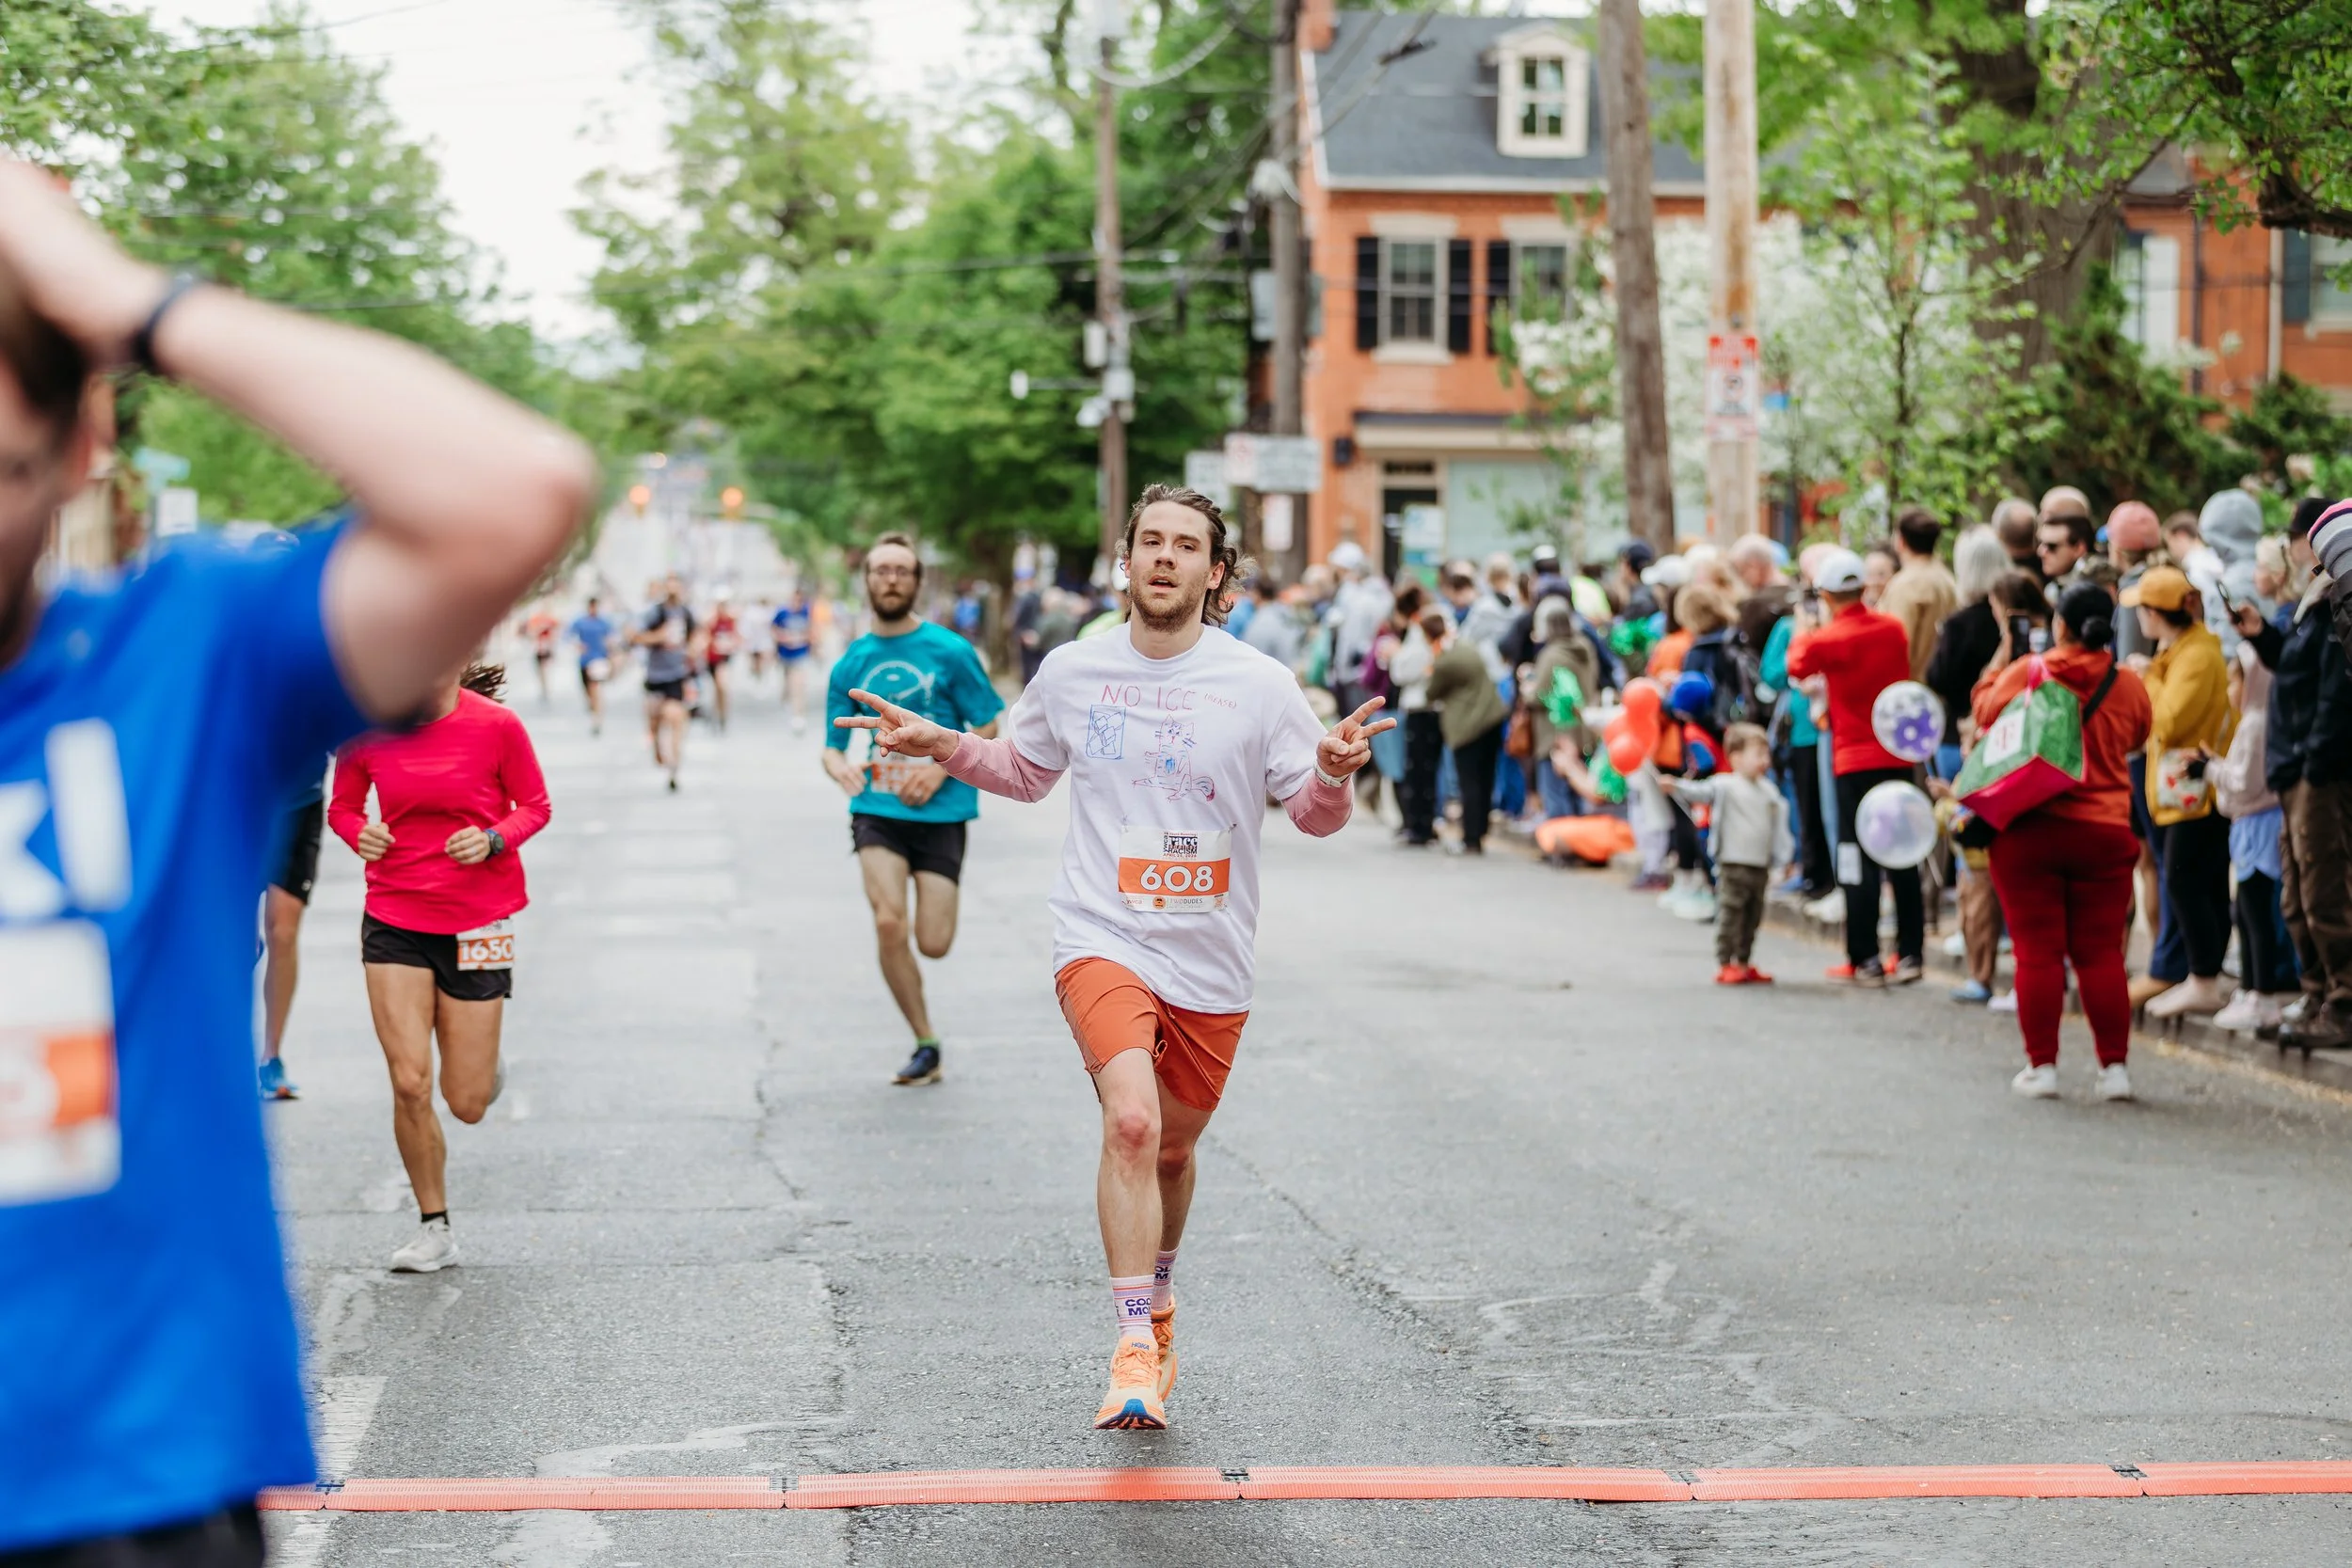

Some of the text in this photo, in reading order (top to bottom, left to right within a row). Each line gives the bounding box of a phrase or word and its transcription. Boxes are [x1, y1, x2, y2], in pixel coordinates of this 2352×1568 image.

[1102, 684, 1141, 707] NO
[1156, 688, 1197, 711] ICE
[1168, 837, 1198, 846] race
[1140, 863, 1215, 893] 608
[460, 937, 513, 961] 1650
[1131, 1341, 1150, 1351] HOKA
